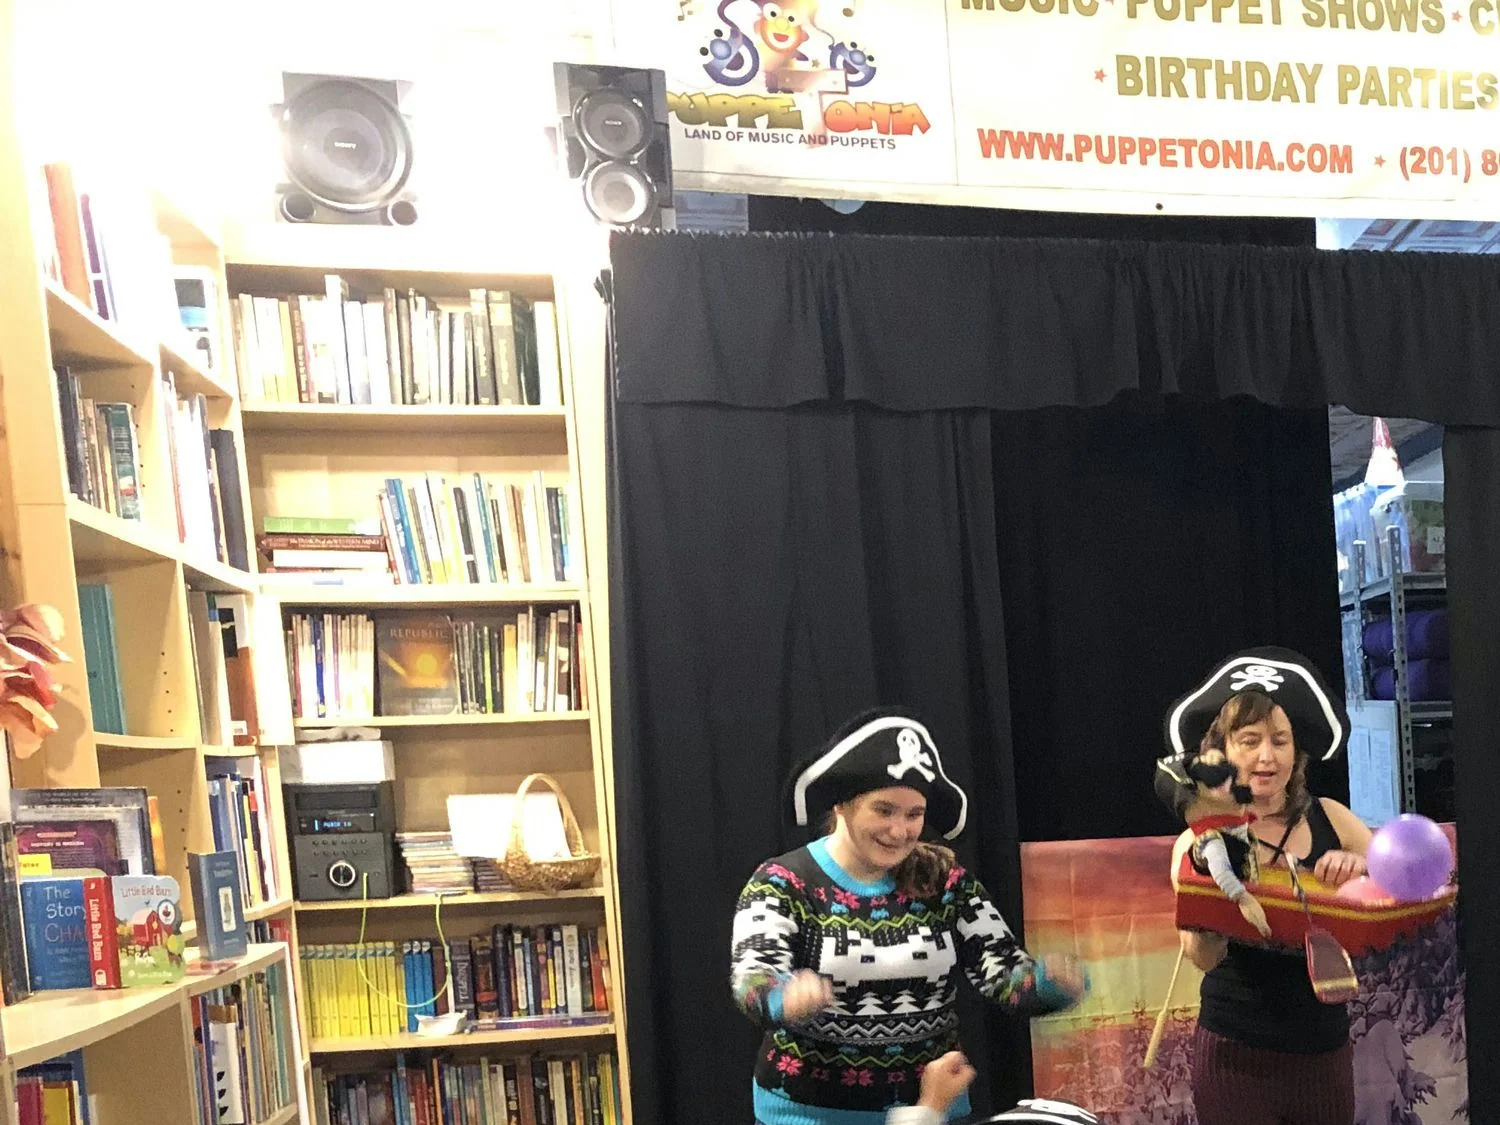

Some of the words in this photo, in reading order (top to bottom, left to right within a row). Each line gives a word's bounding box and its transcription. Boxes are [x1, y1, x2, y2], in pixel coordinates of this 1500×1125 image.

[1302, 0, 1446, 34] SHOWS
[1115, 54, 1324, 104] BIRTHDAY
[1337, 64, 1499, 110] PARTIES
[684, 127, 722, 142] LAND
[725, 131, 744, 143] OF
[748, 131, 794, 145] MUSIC
[799, 133, 828, 146] AND
[831, 135, 897, 150] PUPPETS
[977, 128, 1353, 174] WWW.PUPPETONIA.COM
[1399, 146, 1471, 183] (201)
[389, 628, 447, 639] REPUBLIC
[44, 885, 71, 900] The
[121, 886, 140, 897] Little
[140, 887, 155, 896] Red
[156, 887, 173, 897] Barn
[88, 898, 99, 925] Little
[90, 926, 101, 940] Red
[92, 940, 103, 961] Barn
